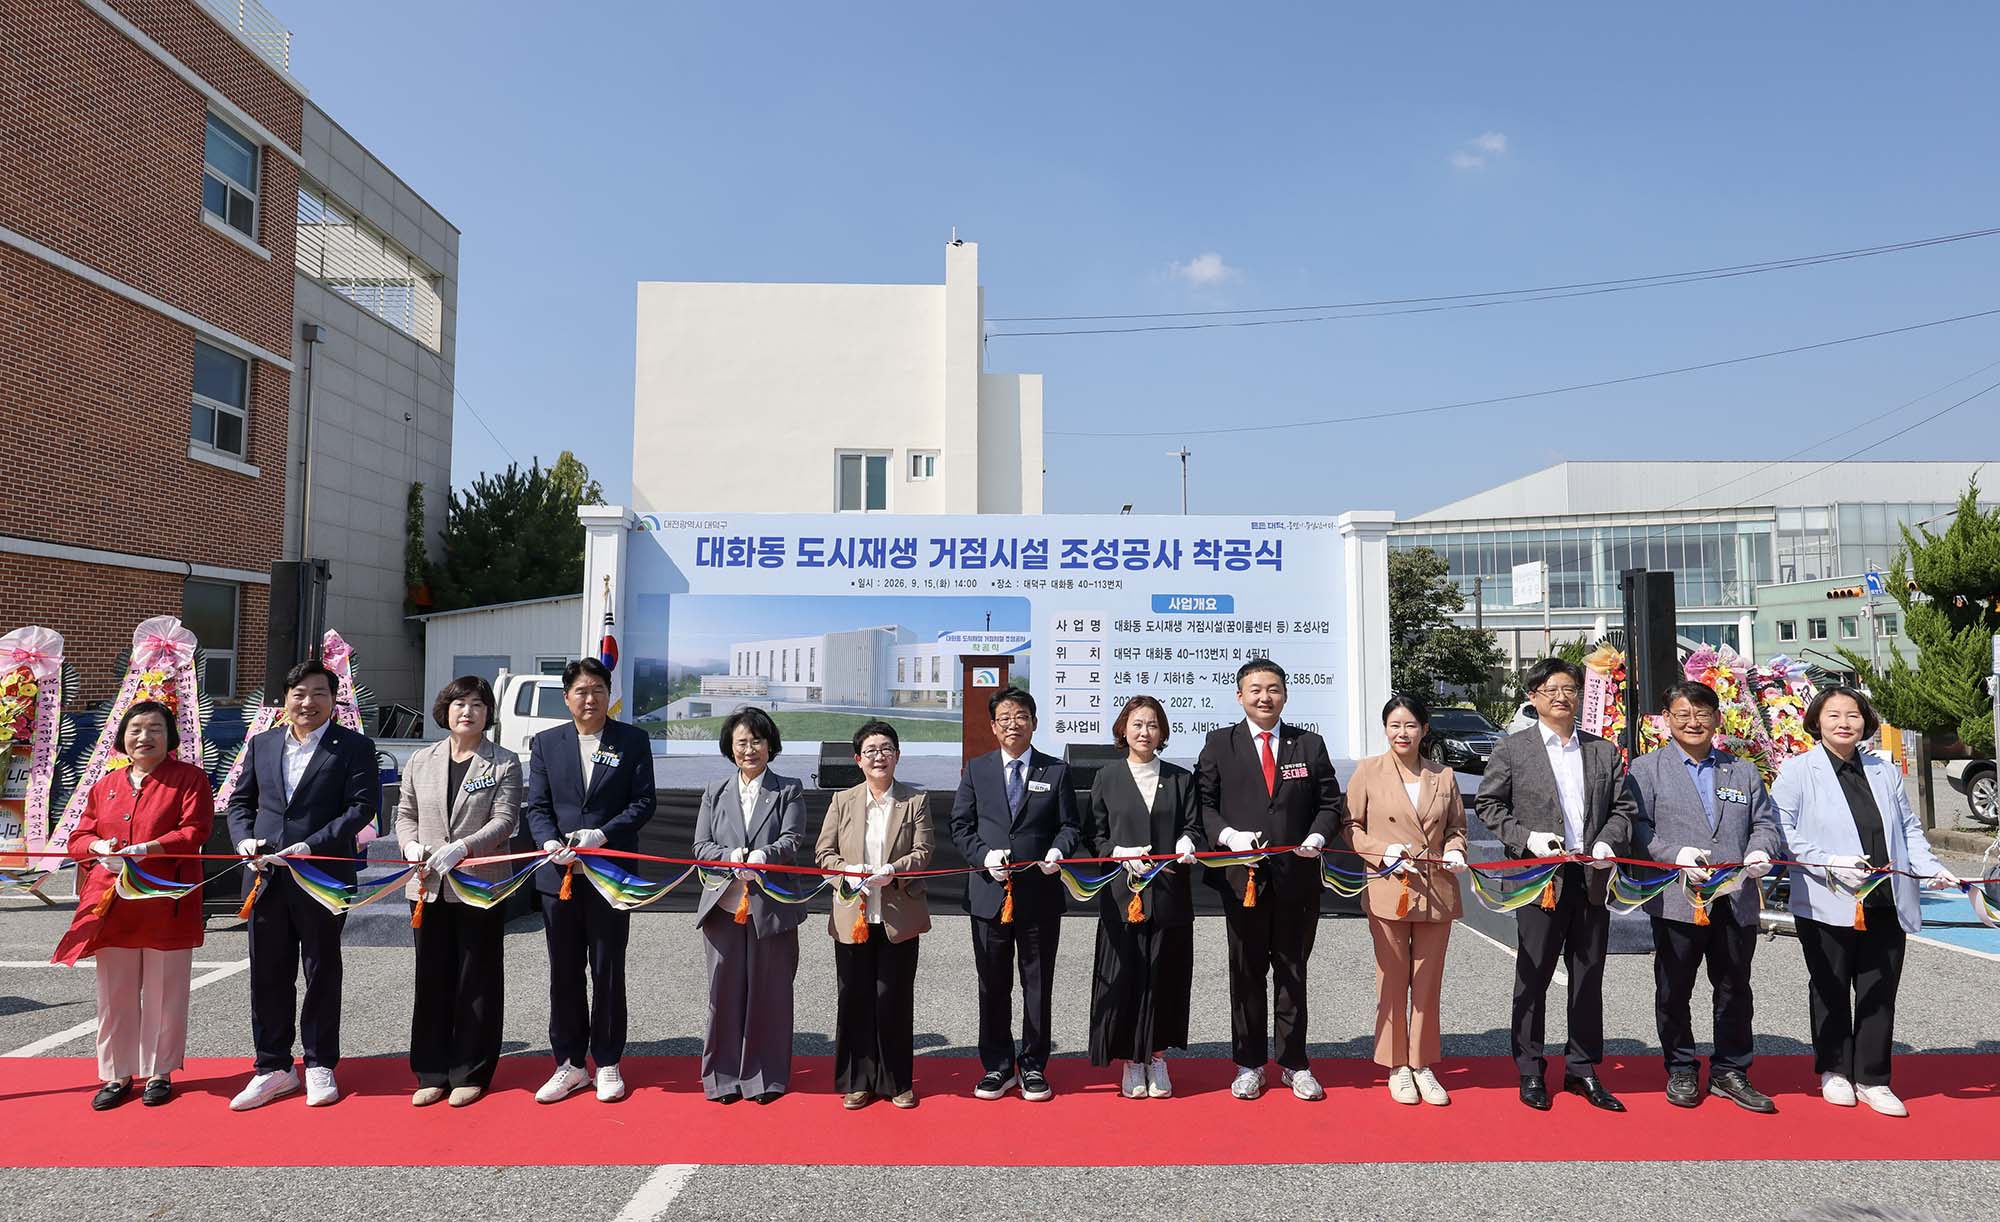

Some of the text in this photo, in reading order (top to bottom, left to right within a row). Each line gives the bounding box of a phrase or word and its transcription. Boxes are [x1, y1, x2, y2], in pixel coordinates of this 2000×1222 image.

[663, 520, 728, 530] 대전광역시 대덕구
[696, 536, 1283, 572] 대화동 도시재생 거점시설 조성공사 착공식
[857, 577, 873, 589] 일시
[884, 579, 907, 589] 2026.
[911, 579, 920, 589] 9.
[924, 579, 951, 590] 15.(화)
[955, 579, 977, 588] 14:00
[996, 578, 1012, 589] 장소
[1023, 579, 1047, 590] 대덕구
[1050, 579, 1074, 590] 대화동
[1078, 579, 1123, 590] 40-113번지
[1168, 597, 1218, 612] 사업개요
[1114, 620, 1330, 634] 대화동 도시재생 거점시설(꿈이룸센터 등) 조성사업
[1114, 648, 1142, 660] 대덕구
[1145, 648, 1173, 660] 대화동
[1177, 648, 1229, 660] 40-113번지
[1232, 648, 1242, 661] 외
[1113, 672, 1132, 685] 신축
[1136, 672, 1150, 685] 1동
[1163, 672, 1195, 685] 지하1층
[1170, 697, 1196, 708] 2027.
[1200, 697, 1214, 708] 12.
[1055, 719, 1101, 733] 총사업비
